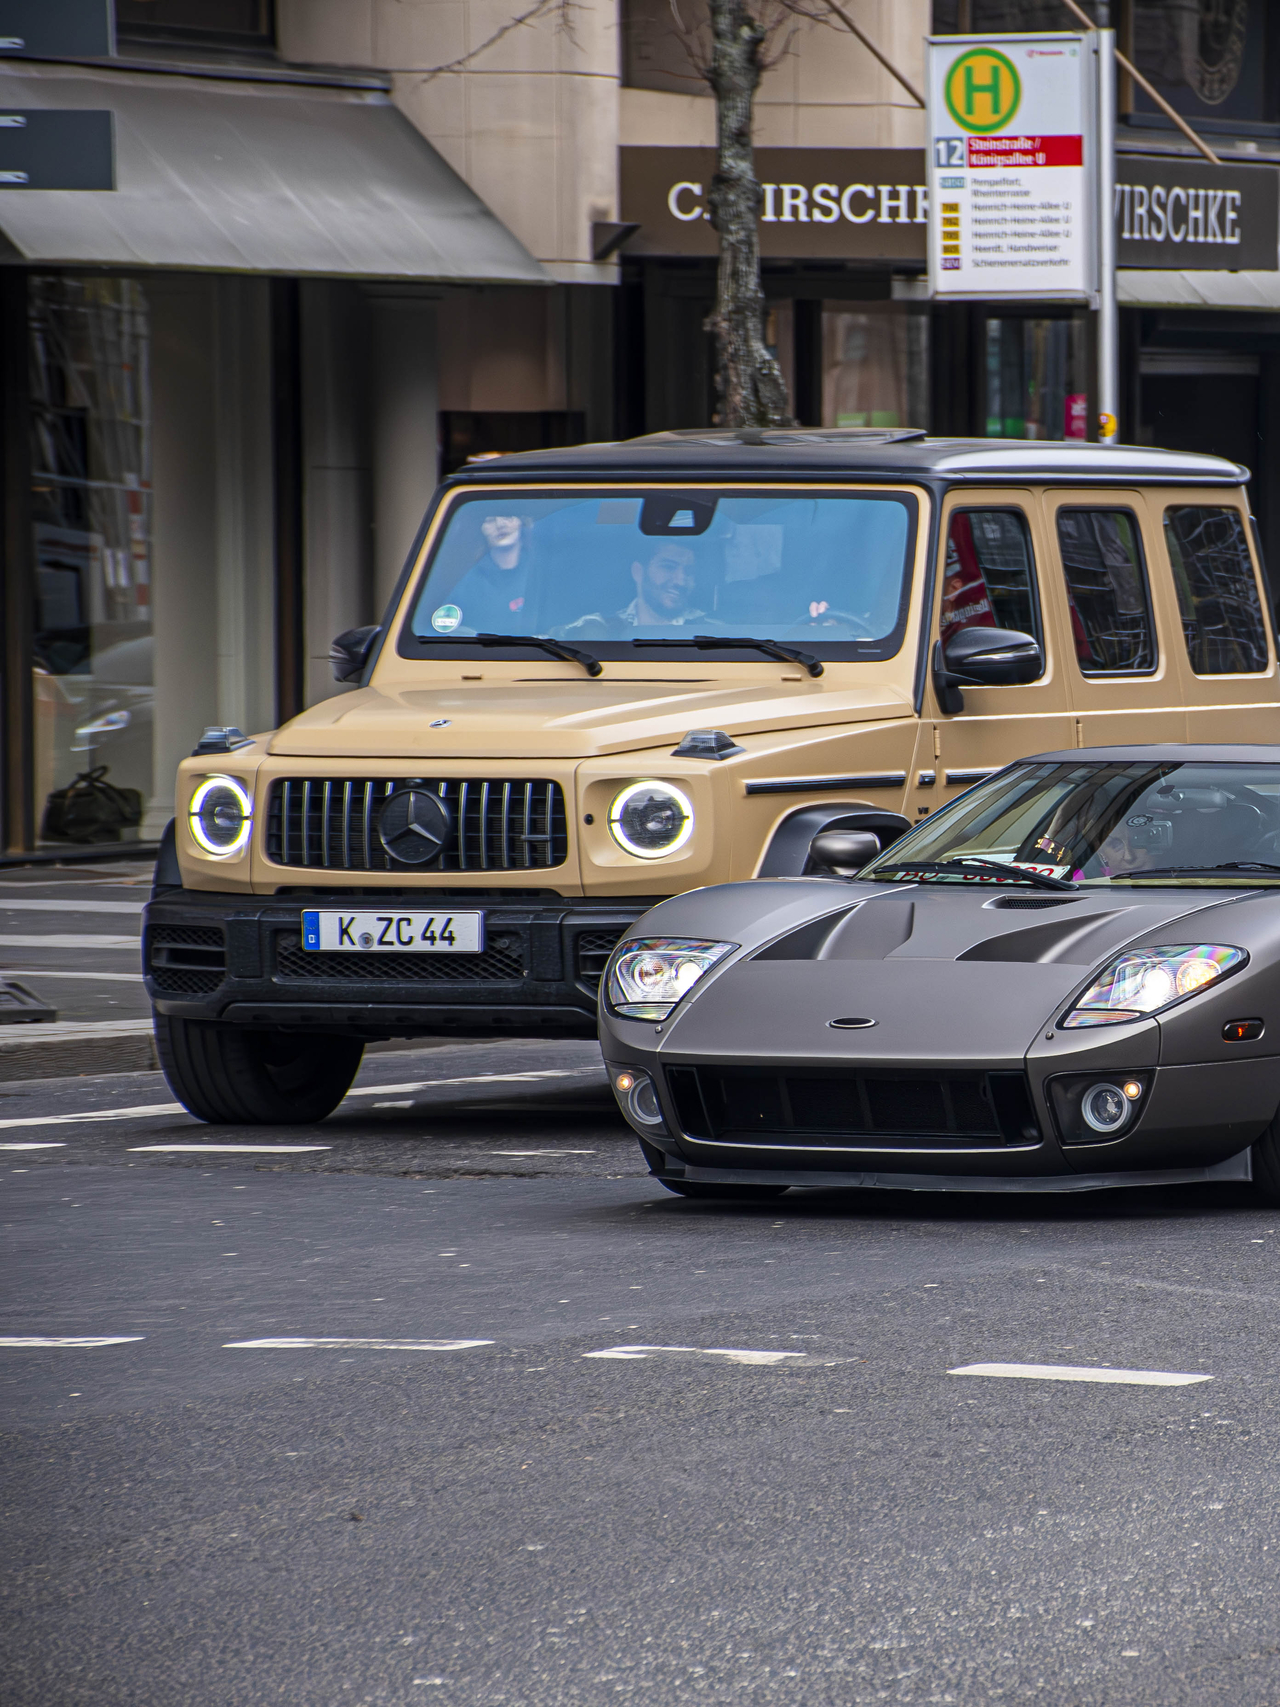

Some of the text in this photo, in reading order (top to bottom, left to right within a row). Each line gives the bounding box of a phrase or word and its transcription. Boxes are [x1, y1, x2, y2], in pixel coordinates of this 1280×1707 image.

[963, 65, 1001, 116] H
[935, 139, 965, 167] 12
[969, 136, 1033, 151] Steinstraße
[970, 151, 1034, 168] Königsallee
[338, 916, 358, 946] K
[376, 916, 414, 947] ZC
[421, 917, 457, 947] 44
